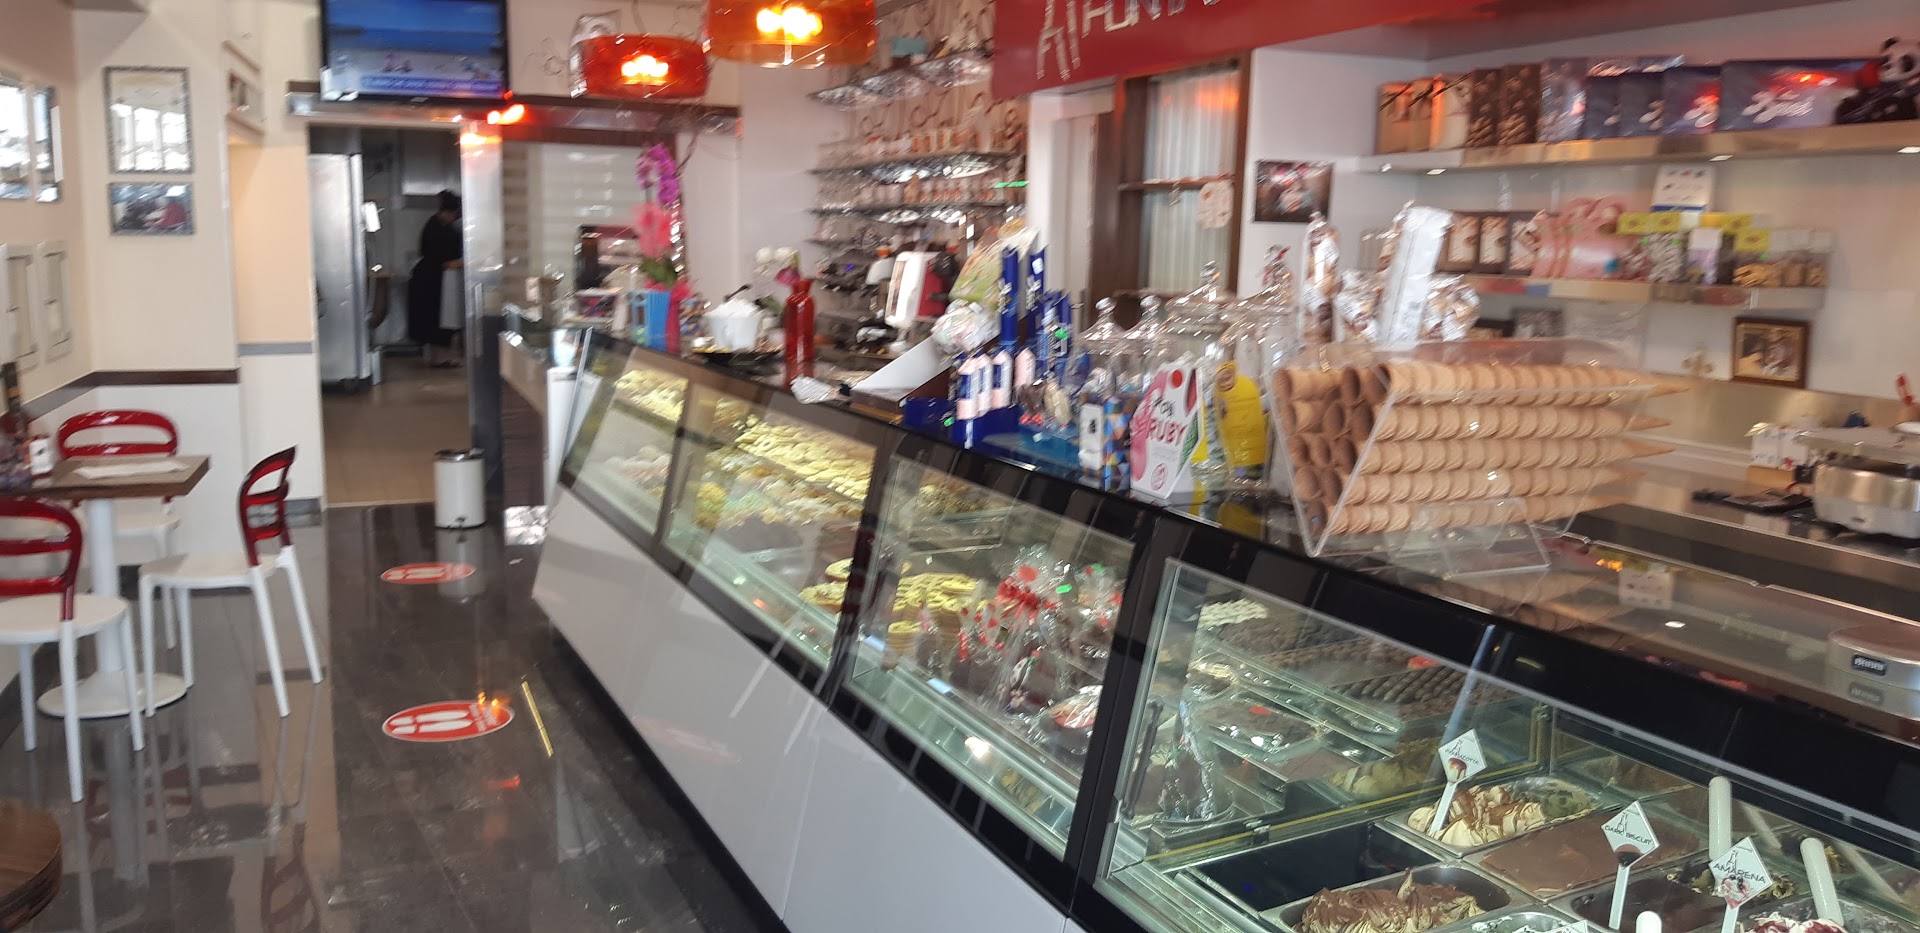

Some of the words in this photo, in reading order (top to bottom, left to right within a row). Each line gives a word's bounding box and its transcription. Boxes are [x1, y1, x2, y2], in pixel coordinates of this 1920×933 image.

[1604, 825, 1624, 836] DARK
[1625, 832, 1652, 845] BISCUIT
[1713, 863, 1766, 884] AMARENA
